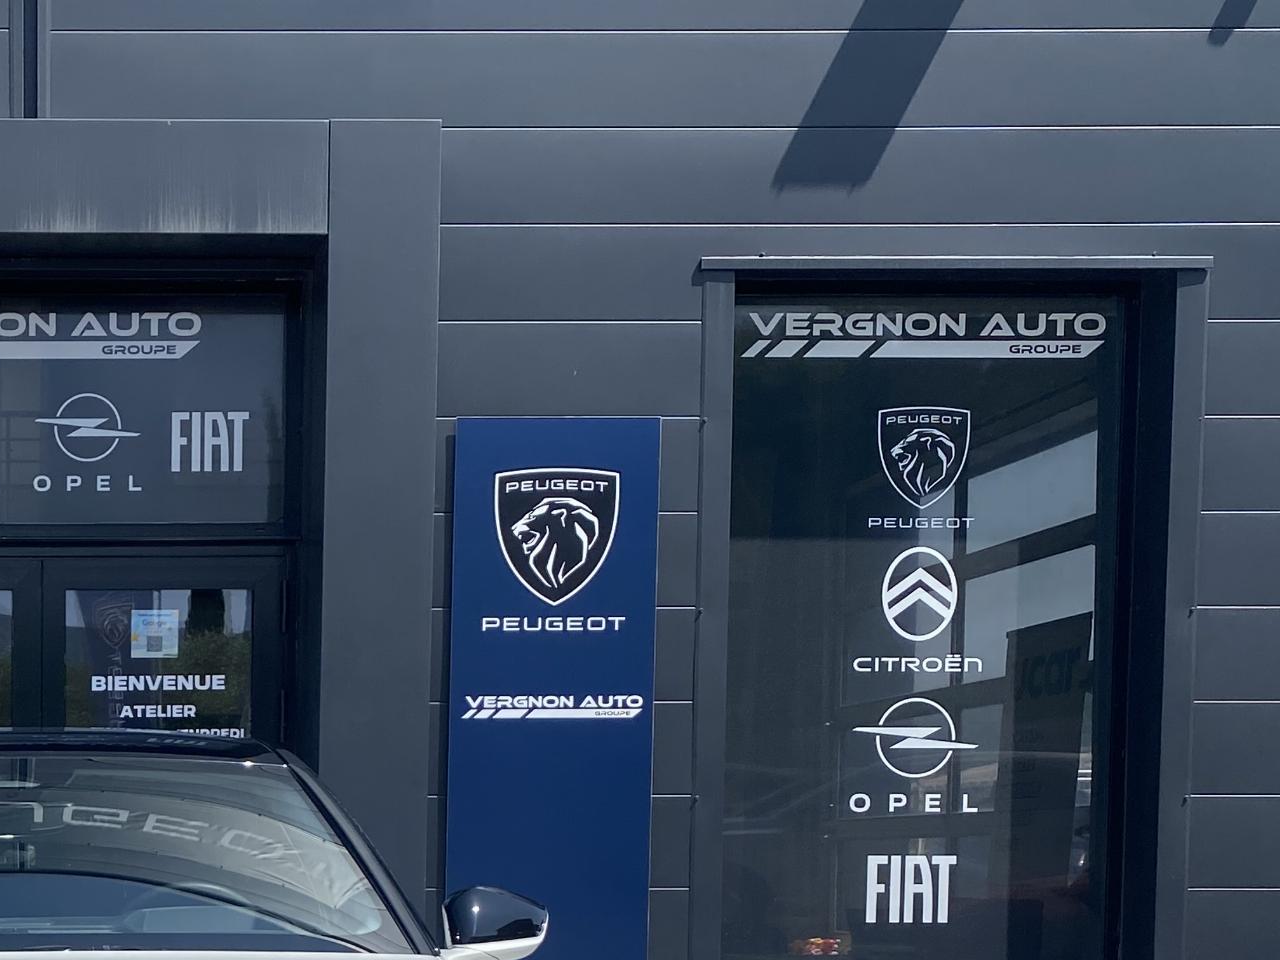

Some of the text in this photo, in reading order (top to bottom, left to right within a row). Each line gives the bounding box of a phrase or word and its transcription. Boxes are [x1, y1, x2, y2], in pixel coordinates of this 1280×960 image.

[70, 312, 203, 338] AUTO
[749, 312, 1107, 337] VERGNON AUTO
[101, 344, 178, 356] GROUPE
[1008, 344, 1083, 355] GROUPE
[885, 414, 963, 426] PEUGEOT
[170, 411, 250, 472] FIAT
[32, 474, 143, 492] OPEL
[505, 479, 609, 494] PEUGEOT
[867, 516, 976, 530] PEUGEOT
[481, 616, 627, 632] PEUGEOT
[91, 674, 226, 692] BIENVENUE
[465, 695, 644, 709] VERGNON AUTO
[120, 704, 197, 718] ATELIER
[848, 792, 979, 813] OPEL
[865, 854, 958, 923] FIAT
